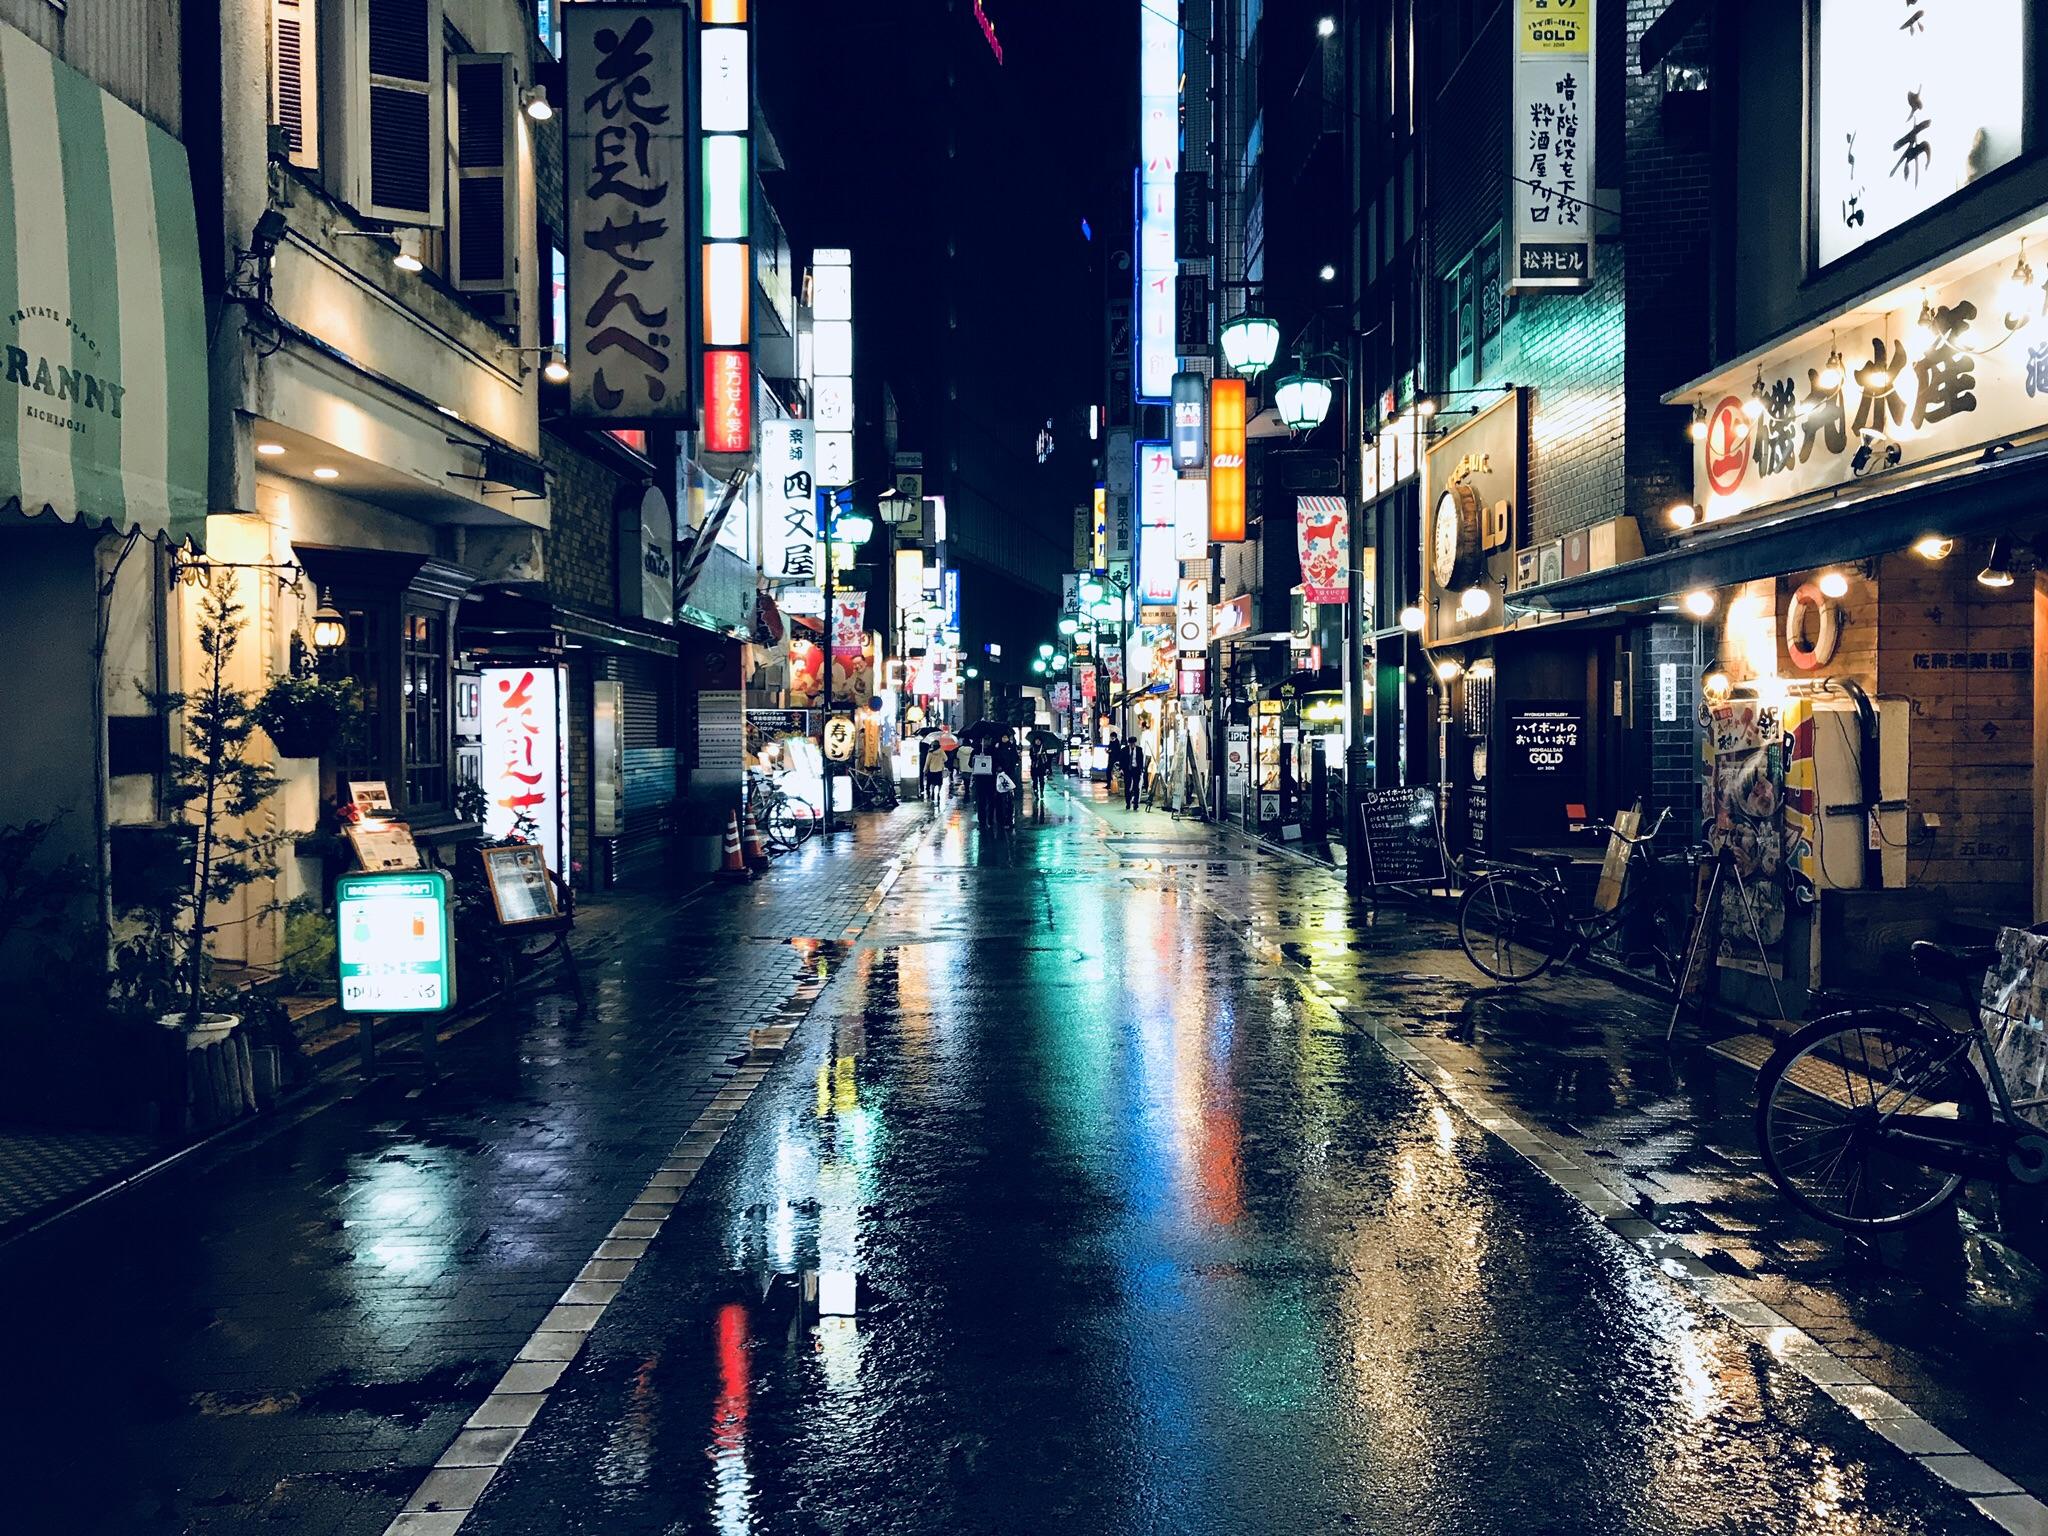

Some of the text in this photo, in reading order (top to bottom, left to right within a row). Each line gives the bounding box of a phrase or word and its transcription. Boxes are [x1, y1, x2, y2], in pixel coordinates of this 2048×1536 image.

[1533, 30, 1576, 41] GOLD
[584, 16, 670, 410] 花見せんべい
[1523, 251, 1583, 271] 松井ビル
[8, 306, 59, 325] PRIVATE
[0, 343, 126, 418] RANNY
[1752, 299, 1977, 479] 磯丸水産
[725, 355, 742, 449] 処方せん受付
[26, 406, 87, 434] KICHIJOJI
[1214, 454, 1243, 468] au
[782, 470, 814, 575] 四文屋
[1482, 499, 1508, 551] LD
[1516, 722, 1577, 733] ハイボールの
[1516, 734, 1577, 746] おいしいお店
[1529, 753, 1563, 764] GOLD
[1378, 788, 1414, 797] ハイボールの
